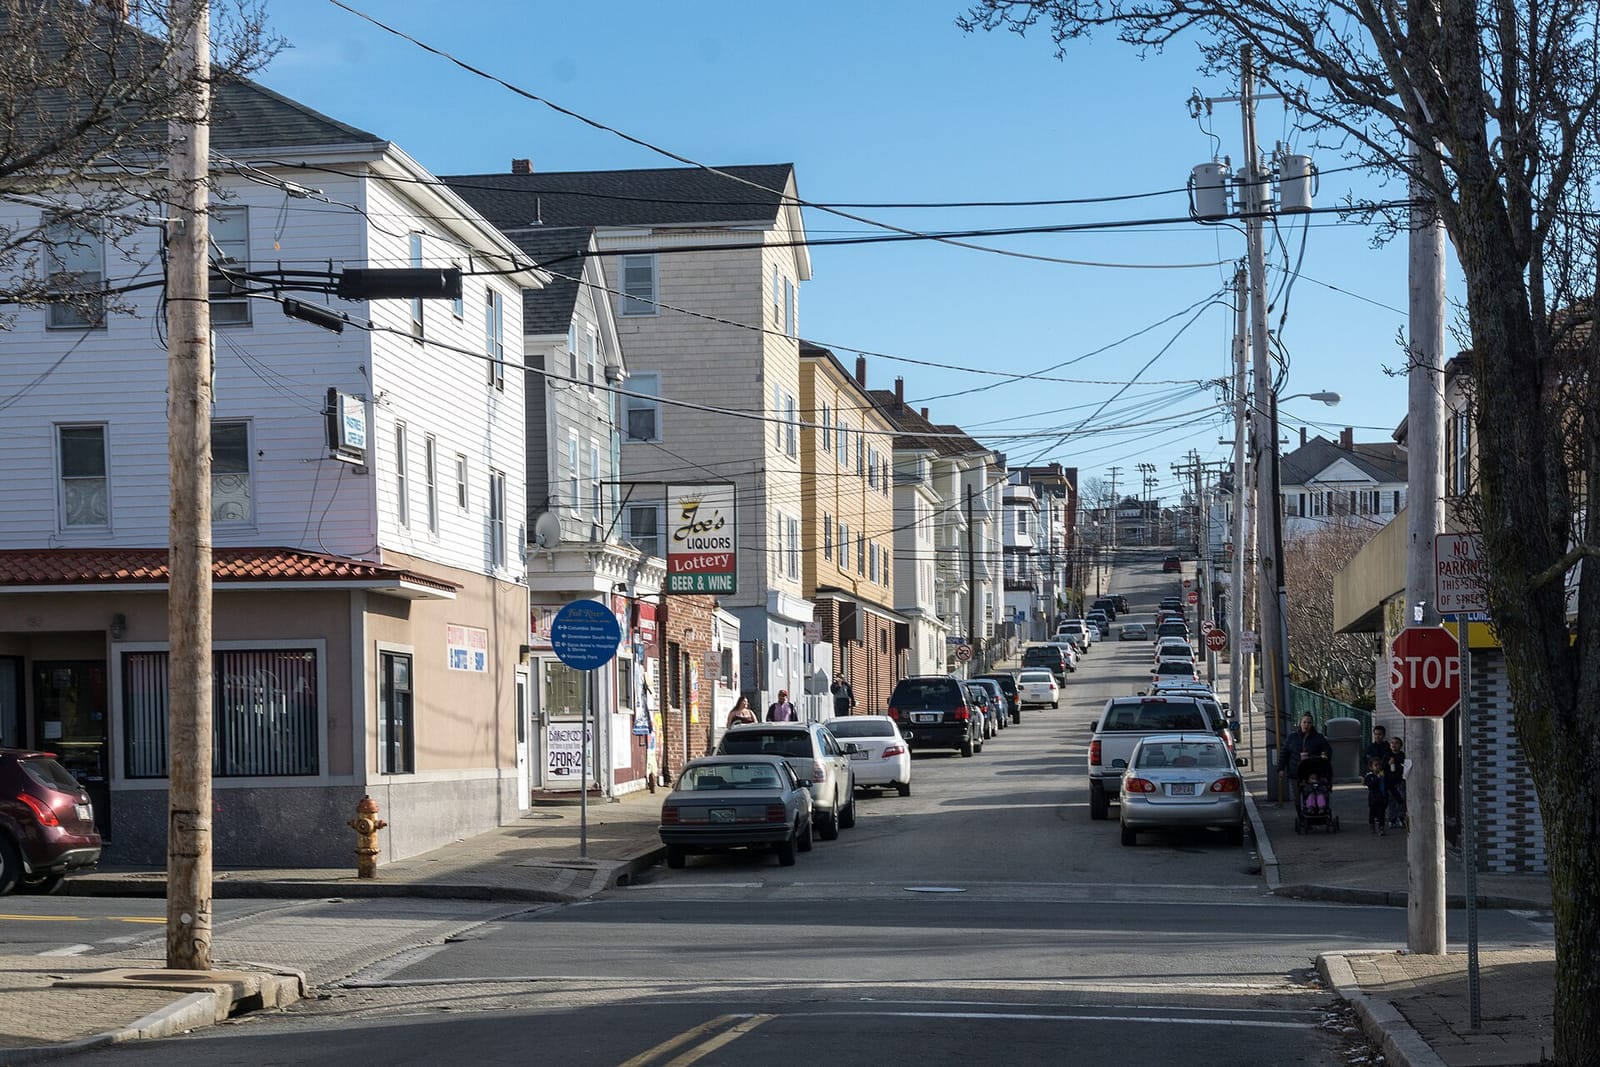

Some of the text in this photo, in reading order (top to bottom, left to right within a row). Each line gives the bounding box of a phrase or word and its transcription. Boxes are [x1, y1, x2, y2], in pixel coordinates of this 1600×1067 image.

[673, 507, 725, 541] Joe's
[687, 537, 731, 550] LIQUORS
[1454, 542, 1468, 556] NO
[674, 554, 729, 573] Lottery
[672, 576, 732, 590] BEER & WINE
[1442, 580, 1459, 591] THIS
[1441, 595, 1451, 605] OF
[1207, 636, 1225, 646] STOP
[1390, 656, 1460, 689] STOP
